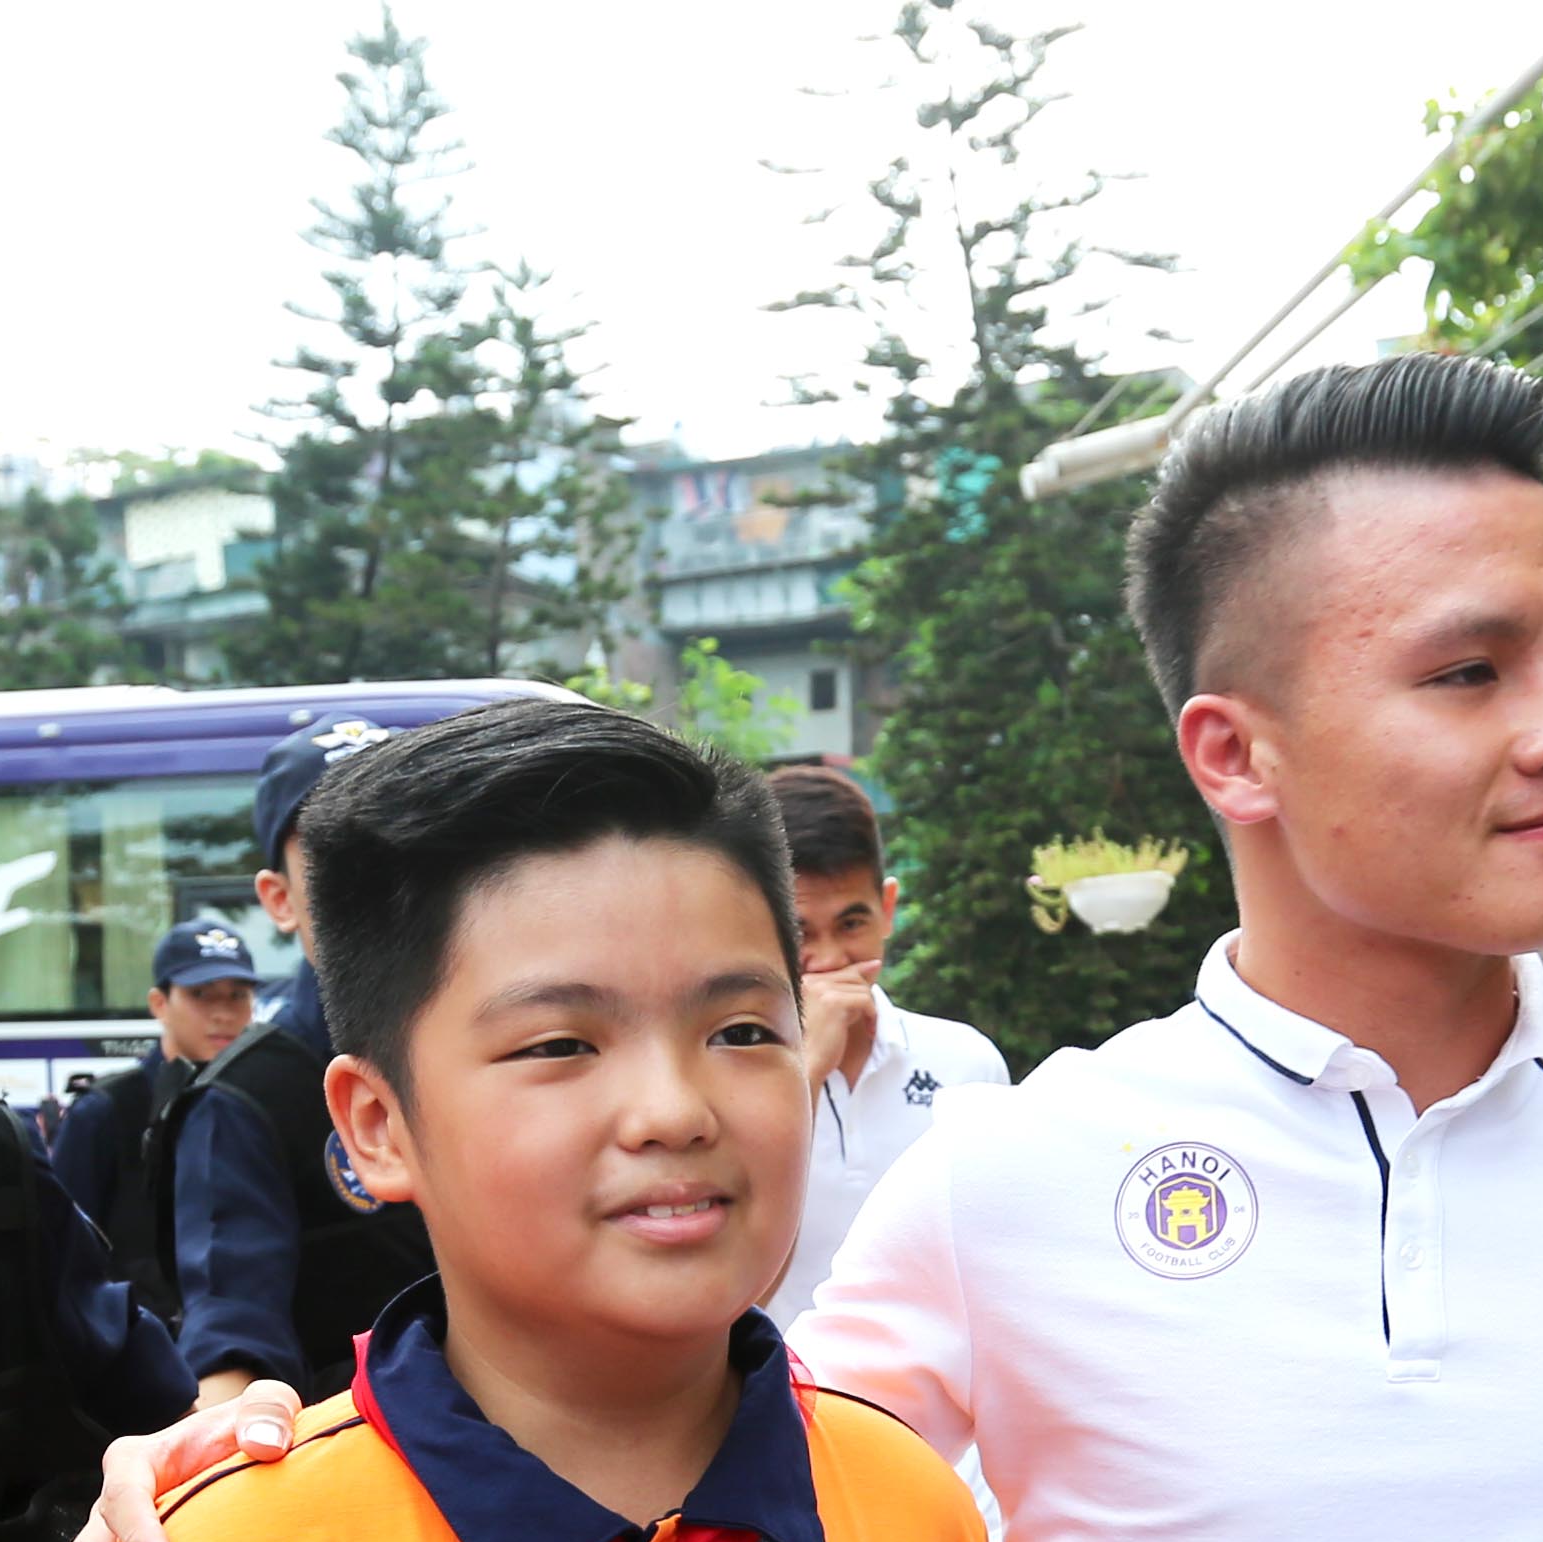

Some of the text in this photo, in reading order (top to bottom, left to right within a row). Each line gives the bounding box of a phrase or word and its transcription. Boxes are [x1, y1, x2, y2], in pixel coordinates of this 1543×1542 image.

[1139, 1151, 1232, 1186] HANOI
[1141, 1237, 1236, 1267] FOOTBALL CLUB
